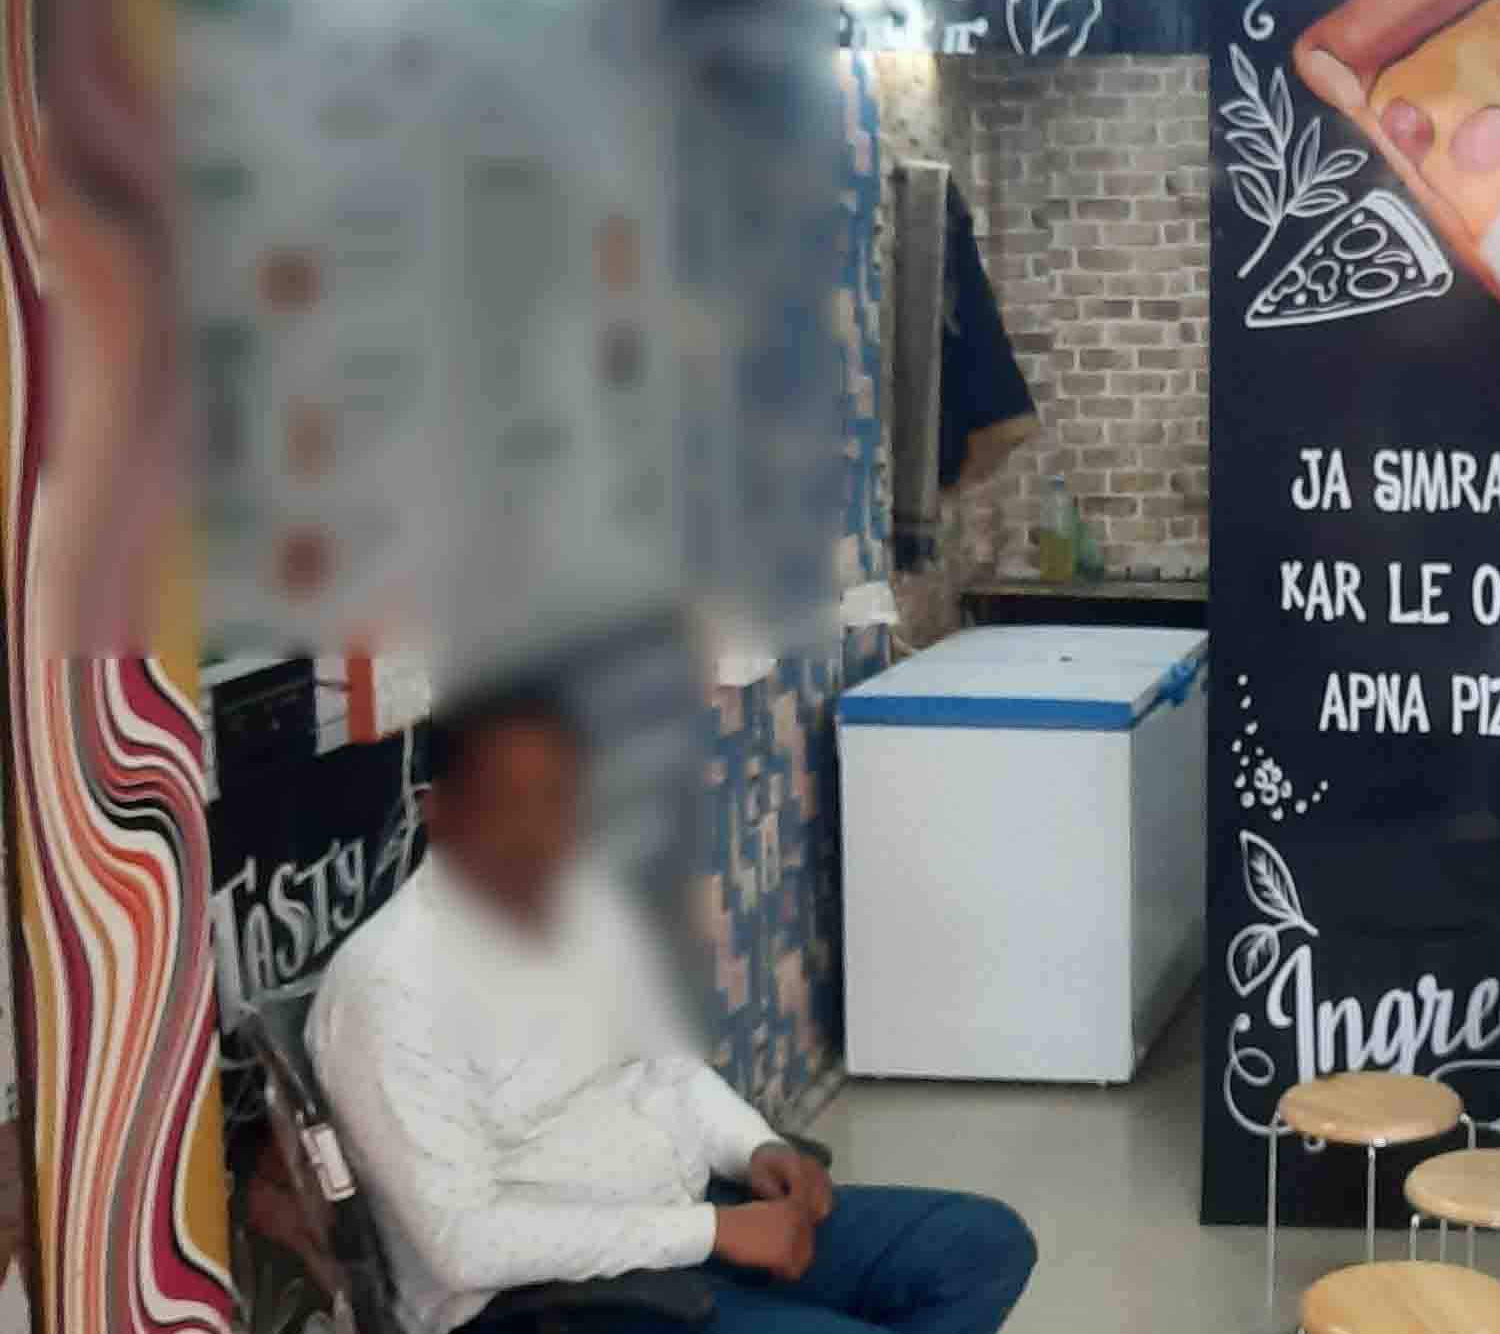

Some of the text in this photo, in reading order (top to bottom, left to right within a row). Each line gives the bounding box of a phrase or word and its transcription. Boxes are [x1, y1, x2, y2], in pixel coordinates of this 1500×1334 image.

[1291, 449, 1353, 511] JA
[1280, 560, 1367, 624] KAR
[1388, 562, 1453, 625] LE
[1318, 672, 1431, 734] APNA
